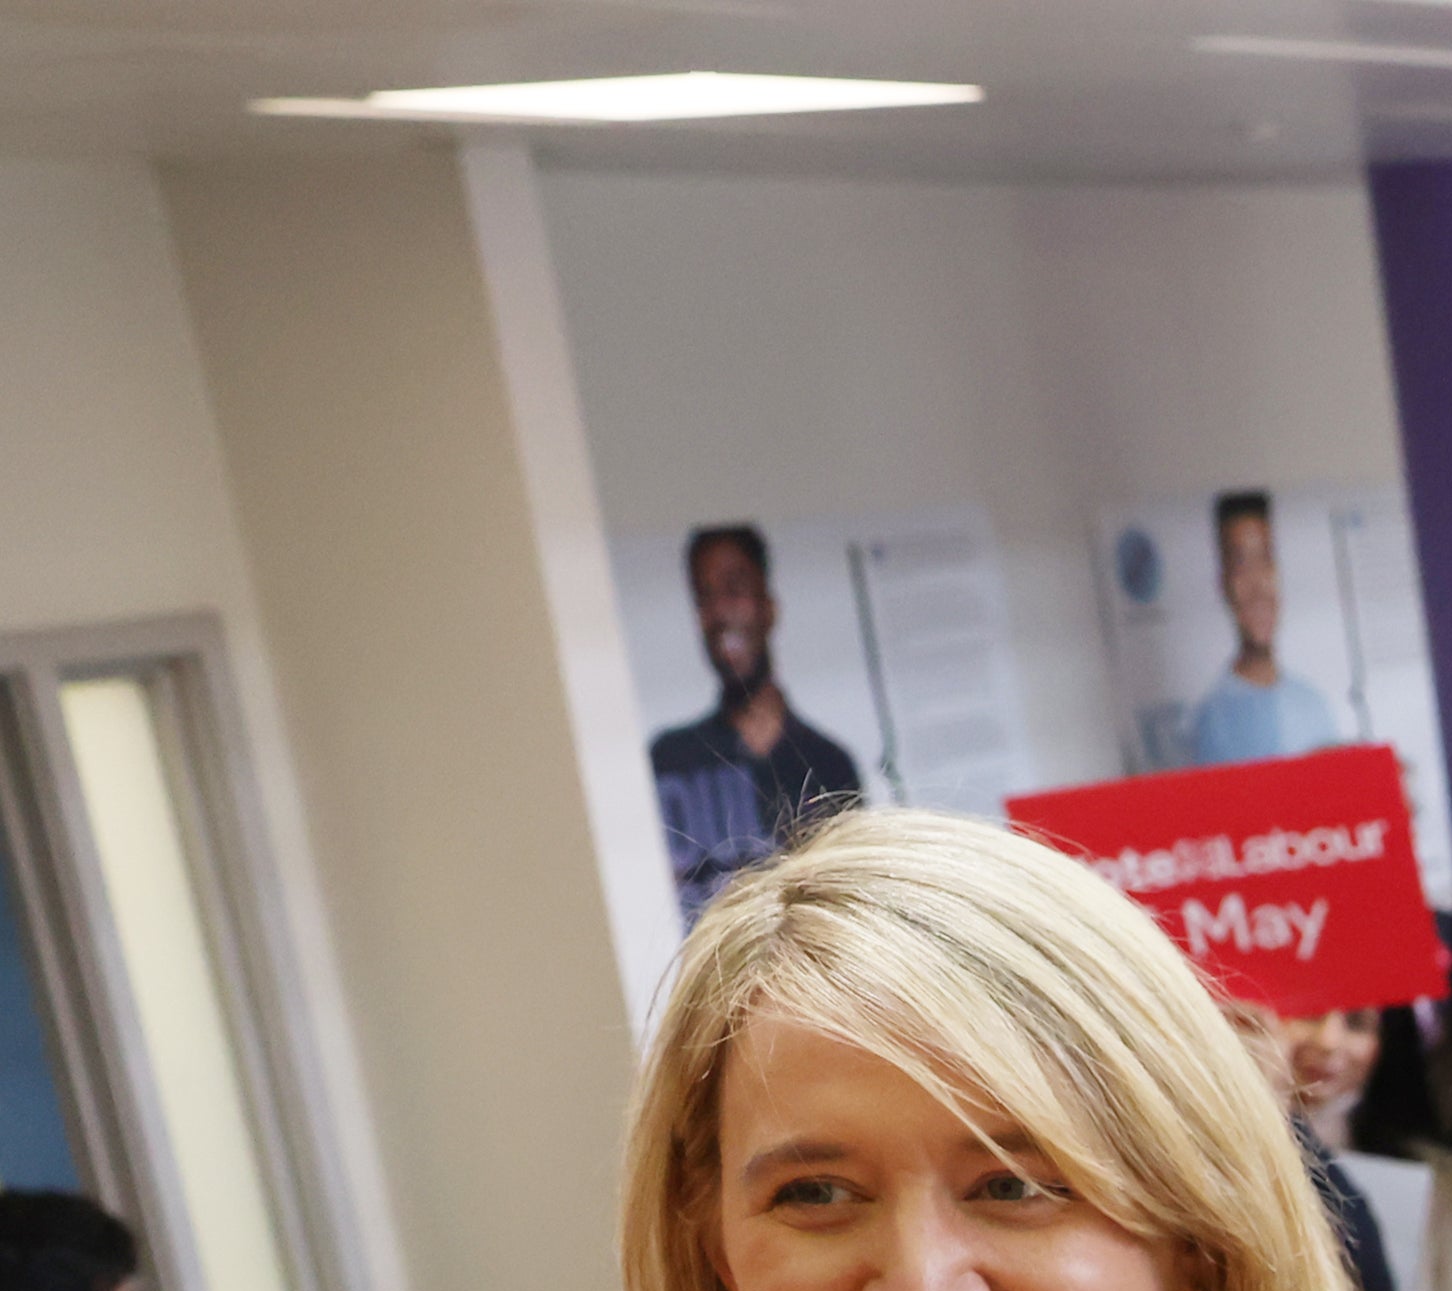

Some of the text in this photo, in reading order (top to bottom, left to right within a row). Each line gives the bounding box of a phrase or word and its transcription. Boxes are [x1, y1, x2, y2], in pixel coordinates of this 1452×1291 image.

[1090, 819, 1389, 894] ote Labour
[1180, 891, 1330, 963] May
